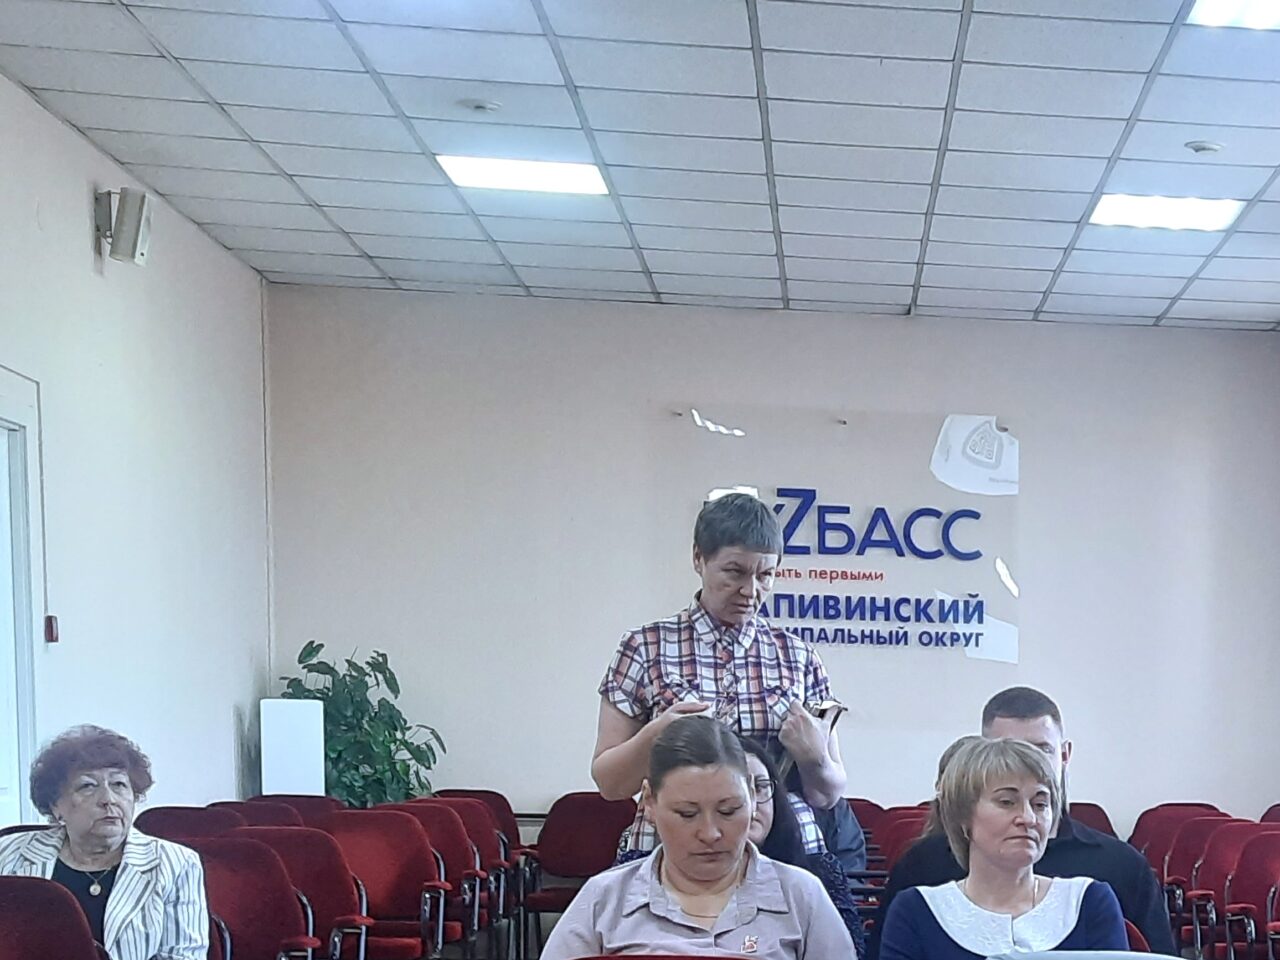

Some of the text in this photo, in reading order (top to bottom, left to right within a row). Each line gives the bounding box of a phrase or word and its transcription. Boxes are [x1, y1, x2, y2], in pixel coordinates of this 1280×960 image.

[773, 488, 983, 561] ZБАСС
[775, 568, 883, 584] ыть первыми
[918, 631, 984, 647] ОКРУГ
